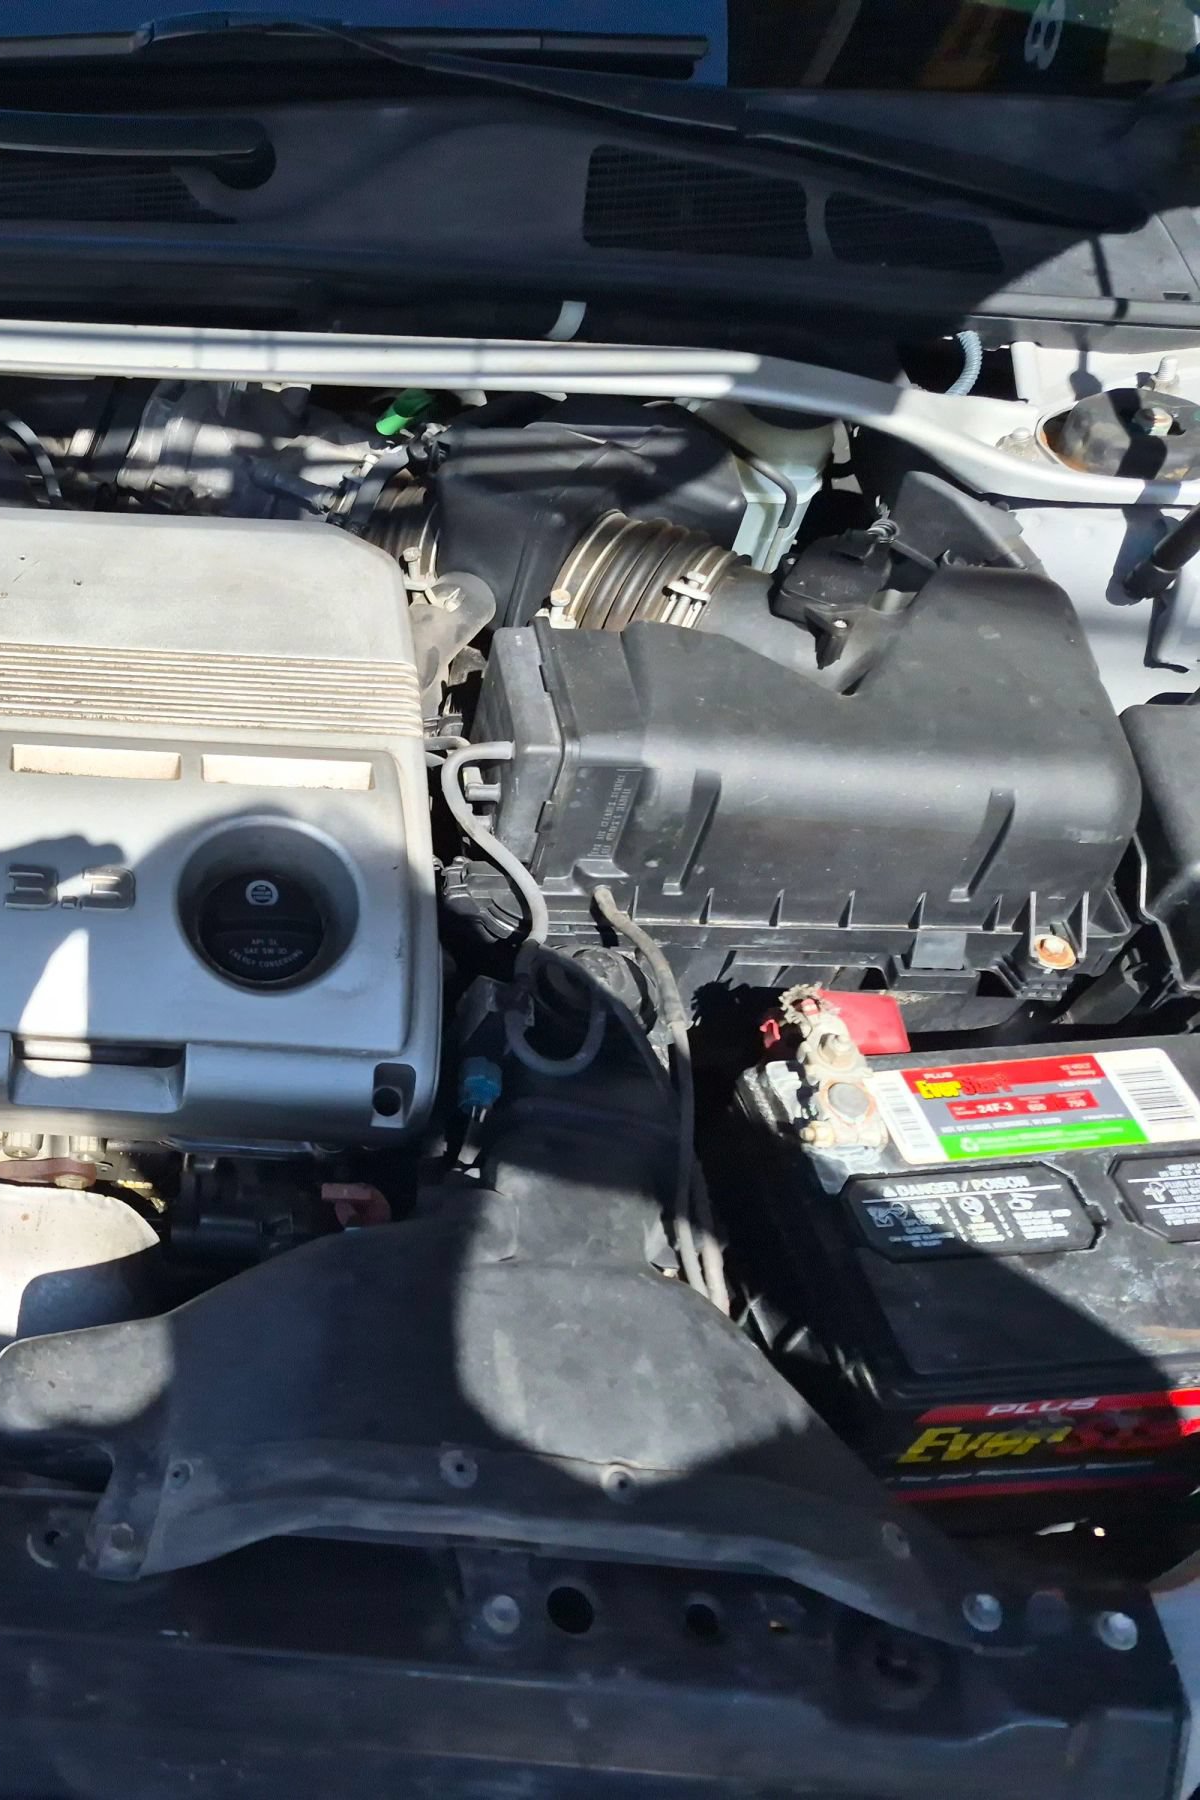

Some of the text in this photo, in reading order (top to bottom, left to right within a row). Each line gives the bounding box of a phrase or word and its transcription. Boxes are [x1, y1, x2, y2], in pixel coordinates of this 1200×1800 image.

[3, 863, 138, 912] 3.3
[896, 1181, 960, 1197] DANGER
[972, 1175, 1031, 1192] POISON
[986, 1396, 1100, 1417] PLUS
